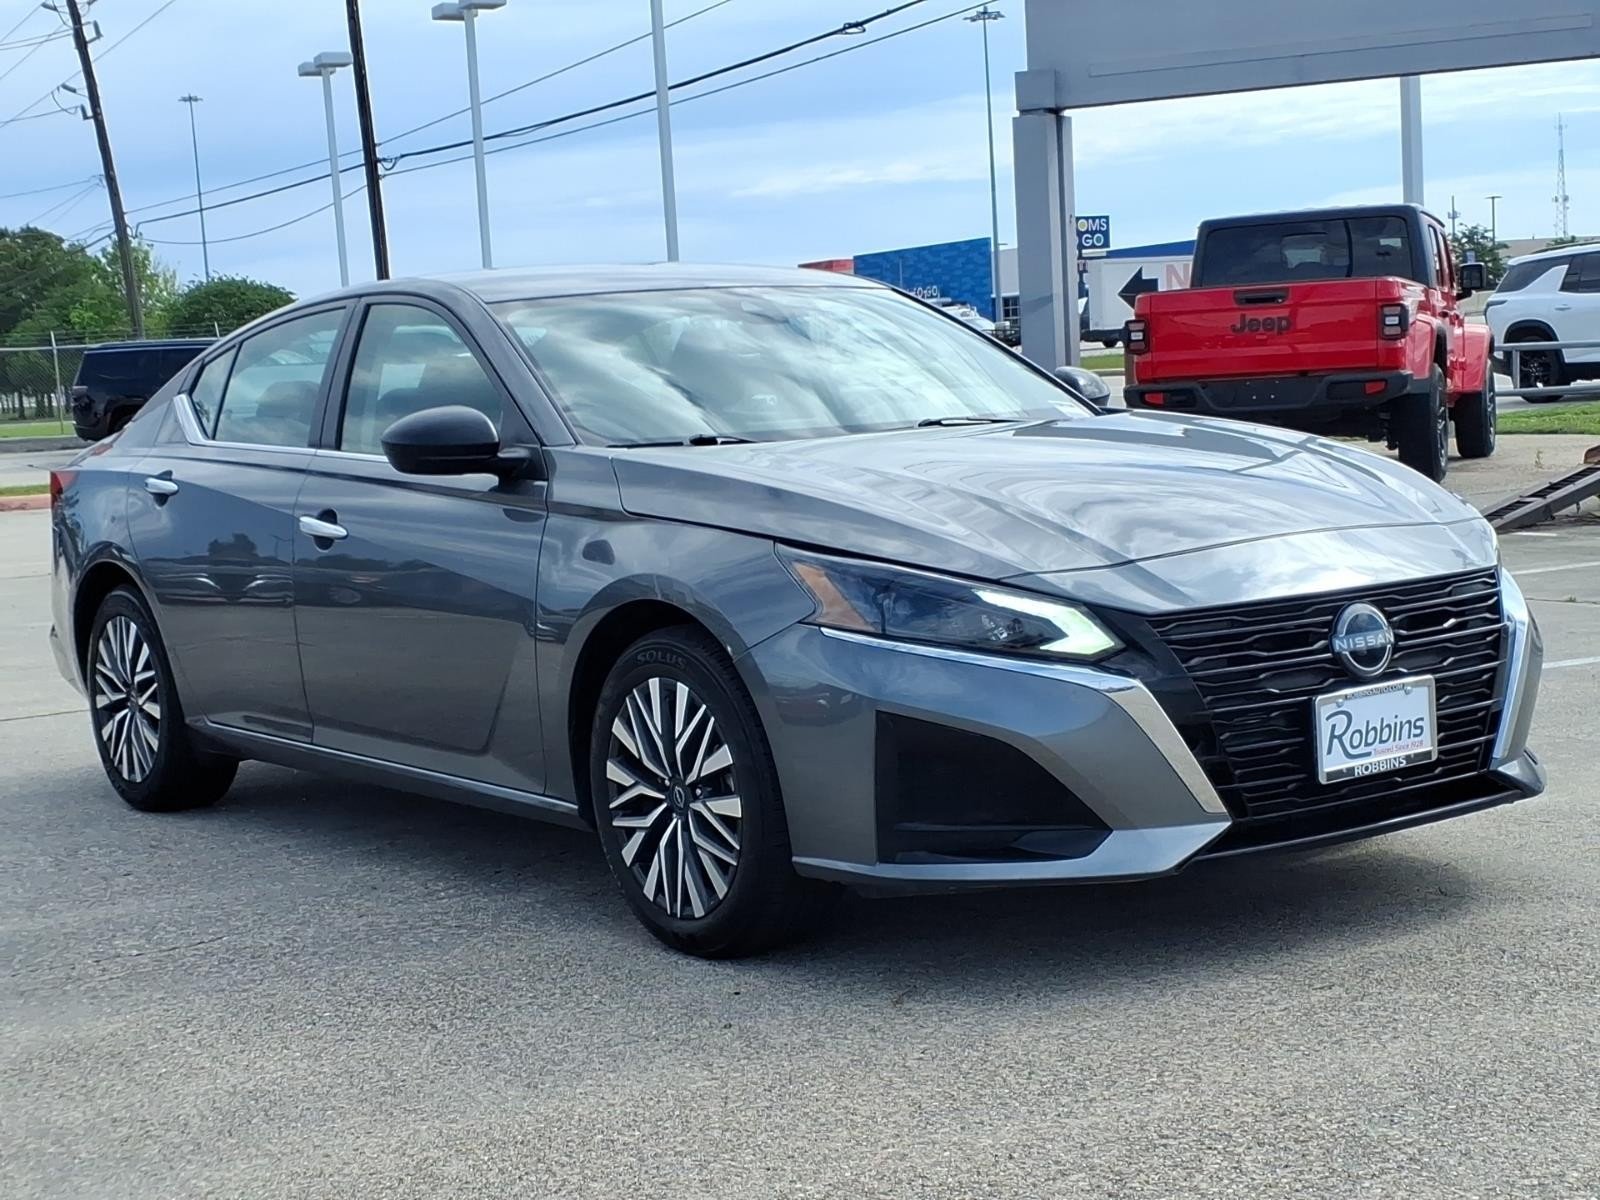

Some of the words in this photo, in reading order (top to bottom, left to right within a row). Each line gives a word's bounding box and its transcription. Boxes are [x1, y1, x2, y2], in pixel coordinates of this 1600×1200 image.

[1077, 218, 1107, 232] OMS
[1081, 233, 1104, 247] GO
[1230, 313, 1292, 335] Jeep
[1334, 630, 1395, 651] NISSAN
[636, 649, 687, 671] SOLUS
[1324, 709, 1425, 760] Robbins
[1354, 756, 1407, 777] ROBBINS
